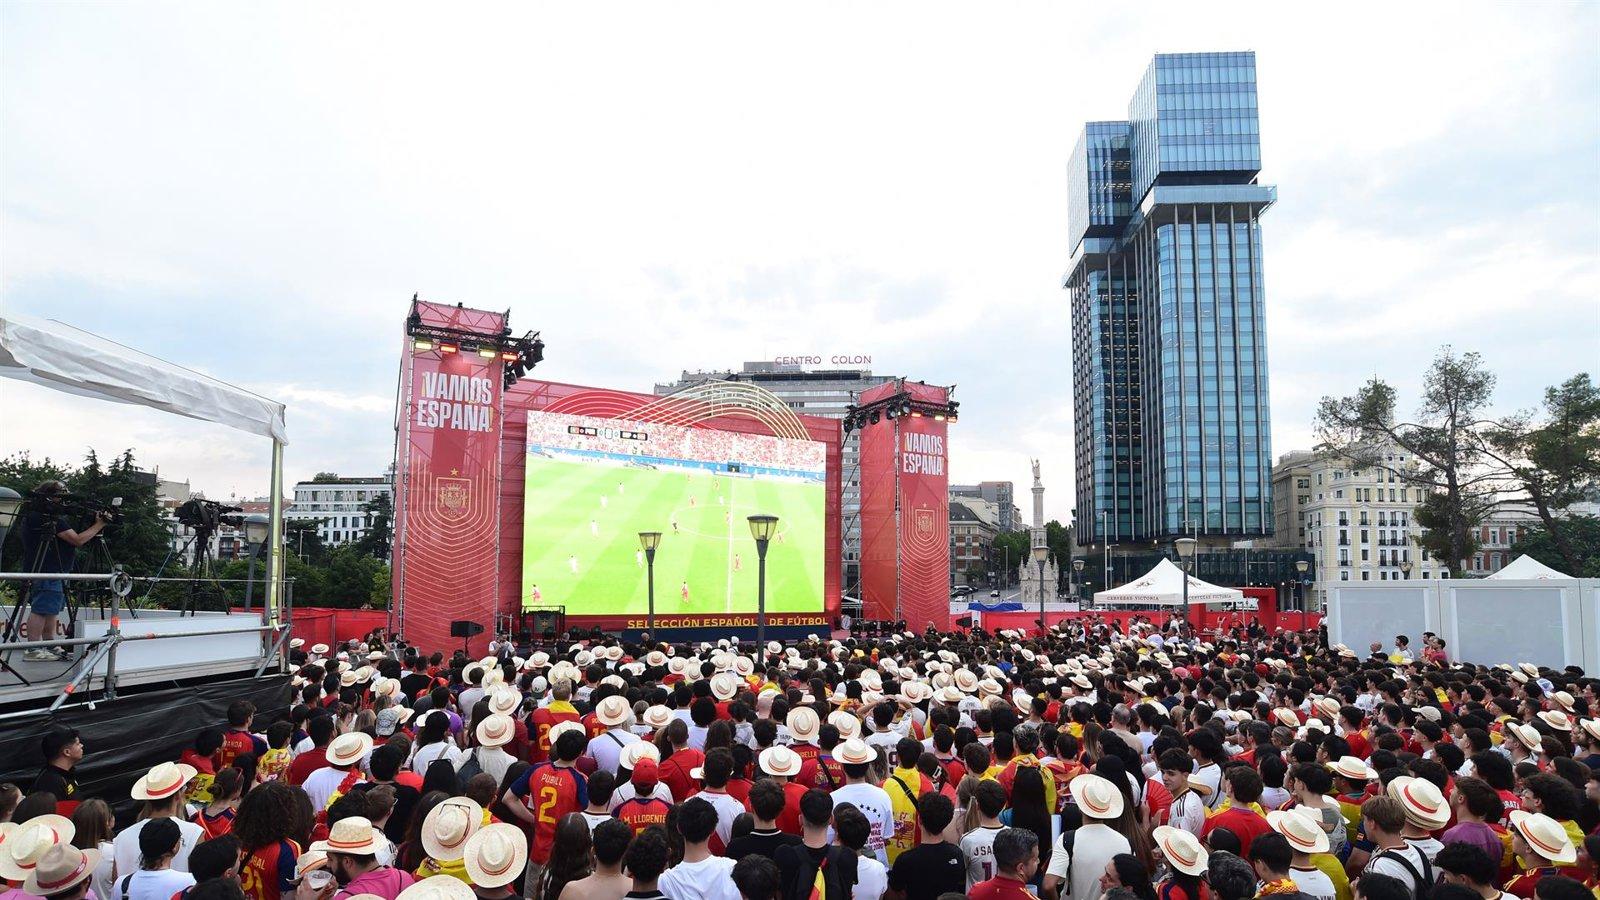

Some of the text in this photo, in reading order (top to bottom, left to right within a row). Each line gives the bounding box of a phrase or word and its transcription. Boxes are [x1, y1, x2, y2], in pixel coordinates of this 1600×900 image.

[775, 355, 872, 365] CENTRO COLON
[417, 399, 494, 433] ESPAÑA!
[627, 616, 829, 629] SELECCIÓN ESPAÑOL DE FÚTBOL
[541, 773, 563, 787] PUBILL
[538, 786, 558, 823] 2
[633, 814, 666, 824] LLORENTE
